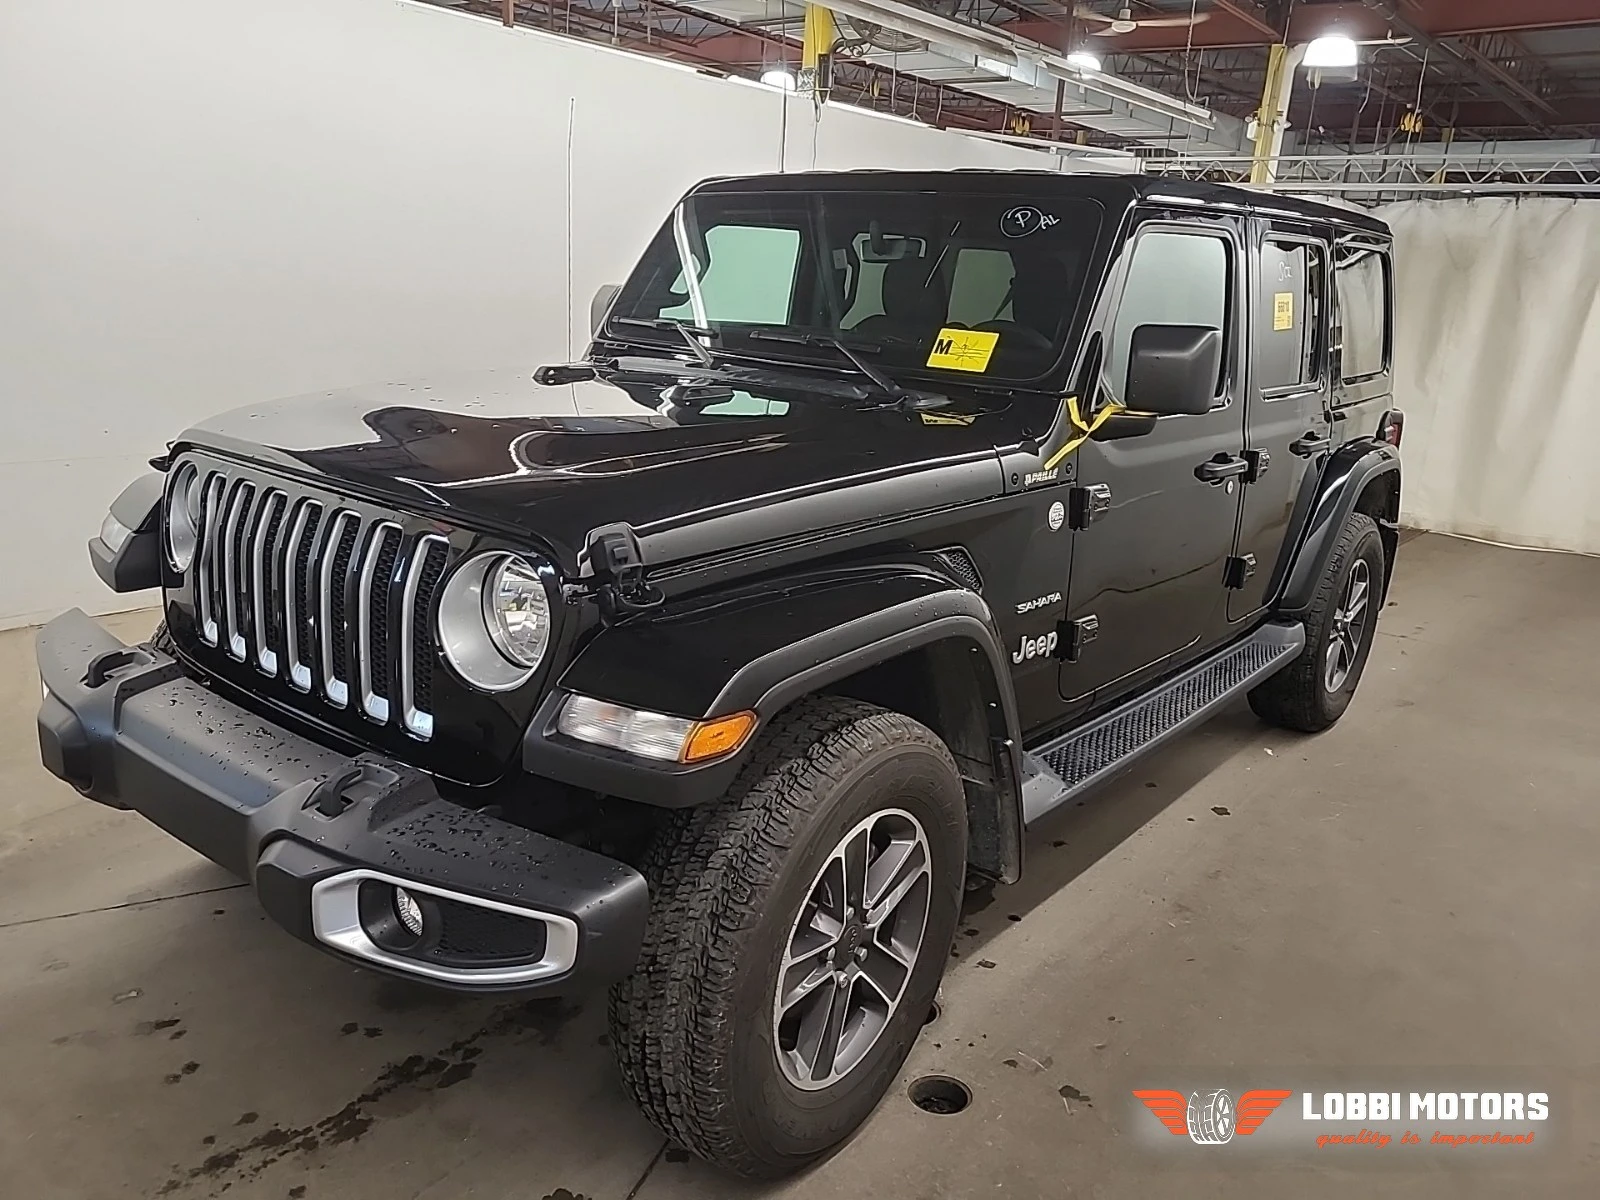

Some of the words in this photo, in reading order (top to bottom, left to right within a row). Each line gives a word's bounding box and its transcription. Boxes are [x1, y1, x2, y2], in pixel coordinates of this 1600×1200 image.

[934, 338, 952, 356] M
[1015, 592, 1062, 614] SAHARA
[1012, 631, 1058, 664] Jeep
